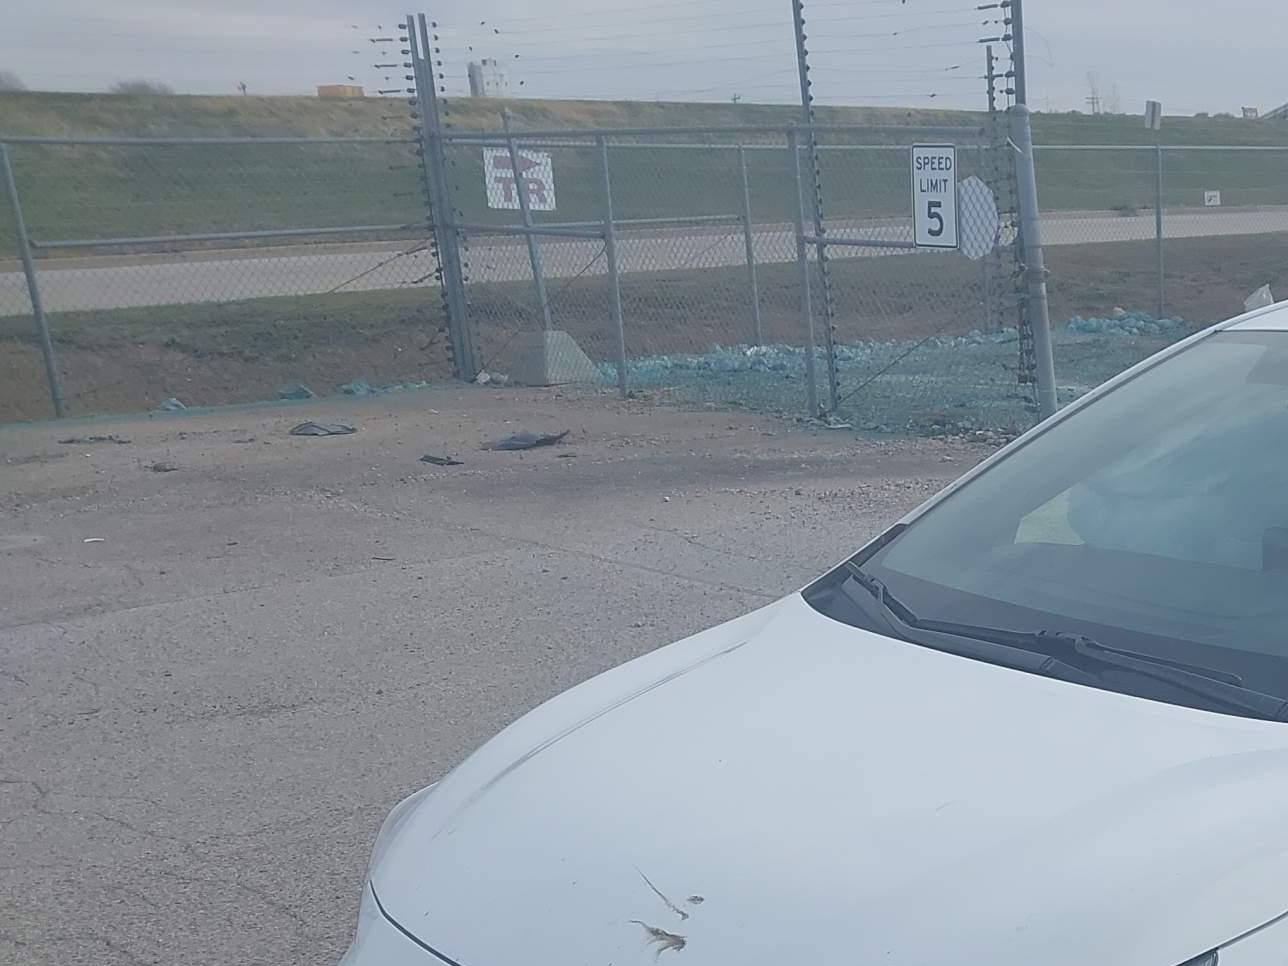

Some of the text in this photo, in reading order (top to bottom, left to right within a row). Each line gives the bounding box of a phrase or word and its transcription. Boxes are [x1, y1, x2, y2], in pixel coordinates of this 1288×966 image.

[916, 156, 952, 171] SPEED
[920, 179, 948, 193] LIMIT
[927, 200, 944, 237] 5
